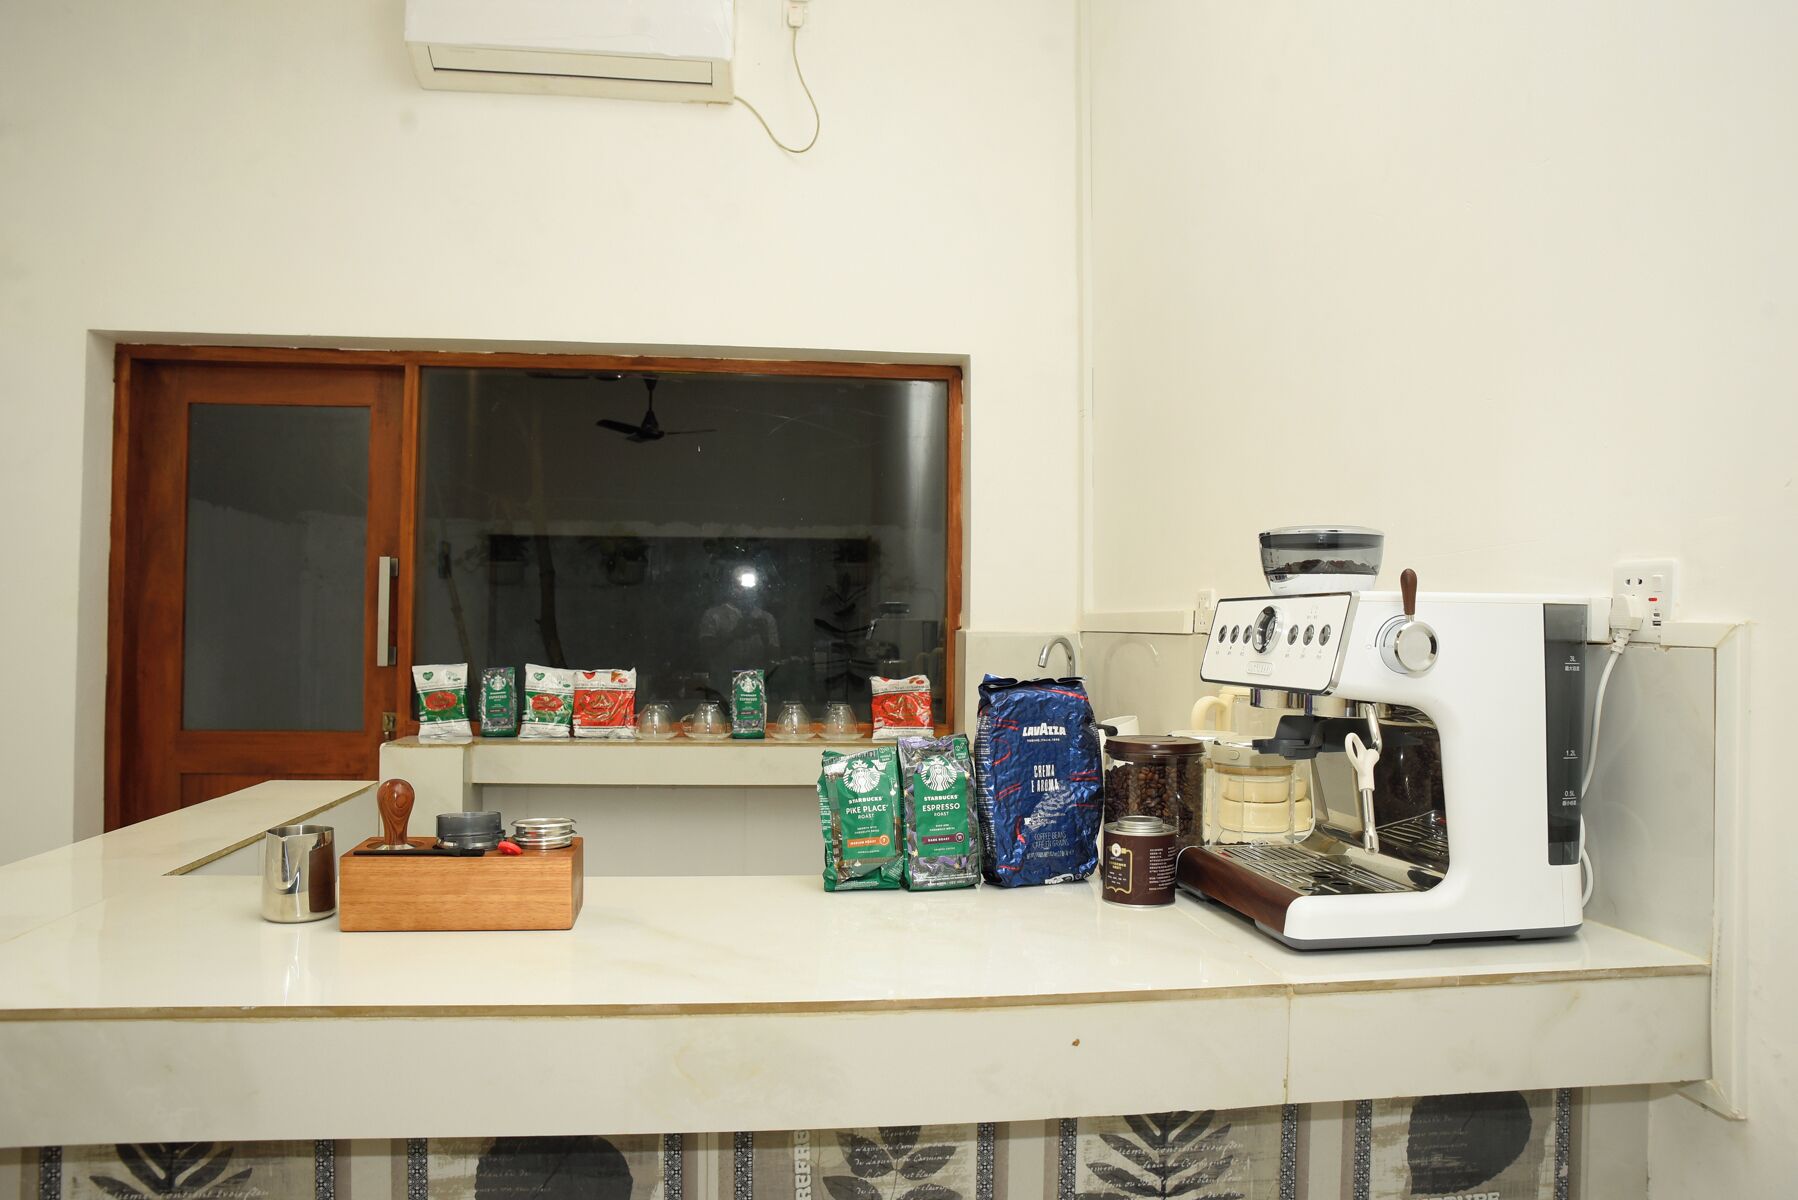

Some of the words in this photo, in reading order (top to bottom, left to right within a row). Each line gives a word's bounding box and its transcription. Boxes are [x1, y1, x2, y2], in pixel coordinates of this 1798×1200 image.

[1022, 722, 1067, 737] LAVAZZA
[1033, 764, 1055, 778] CREMA
[1031, 780, 1035, 792] E
[1037, 778, 1060, 792] AROMA
[848, 796, 883, 805] STARBUCKS
[923, 794, 959, 802] STARBUCKS
[862, 804, 887, 813] PLACE
[922, 803, 961, 812] ESPRESSO
